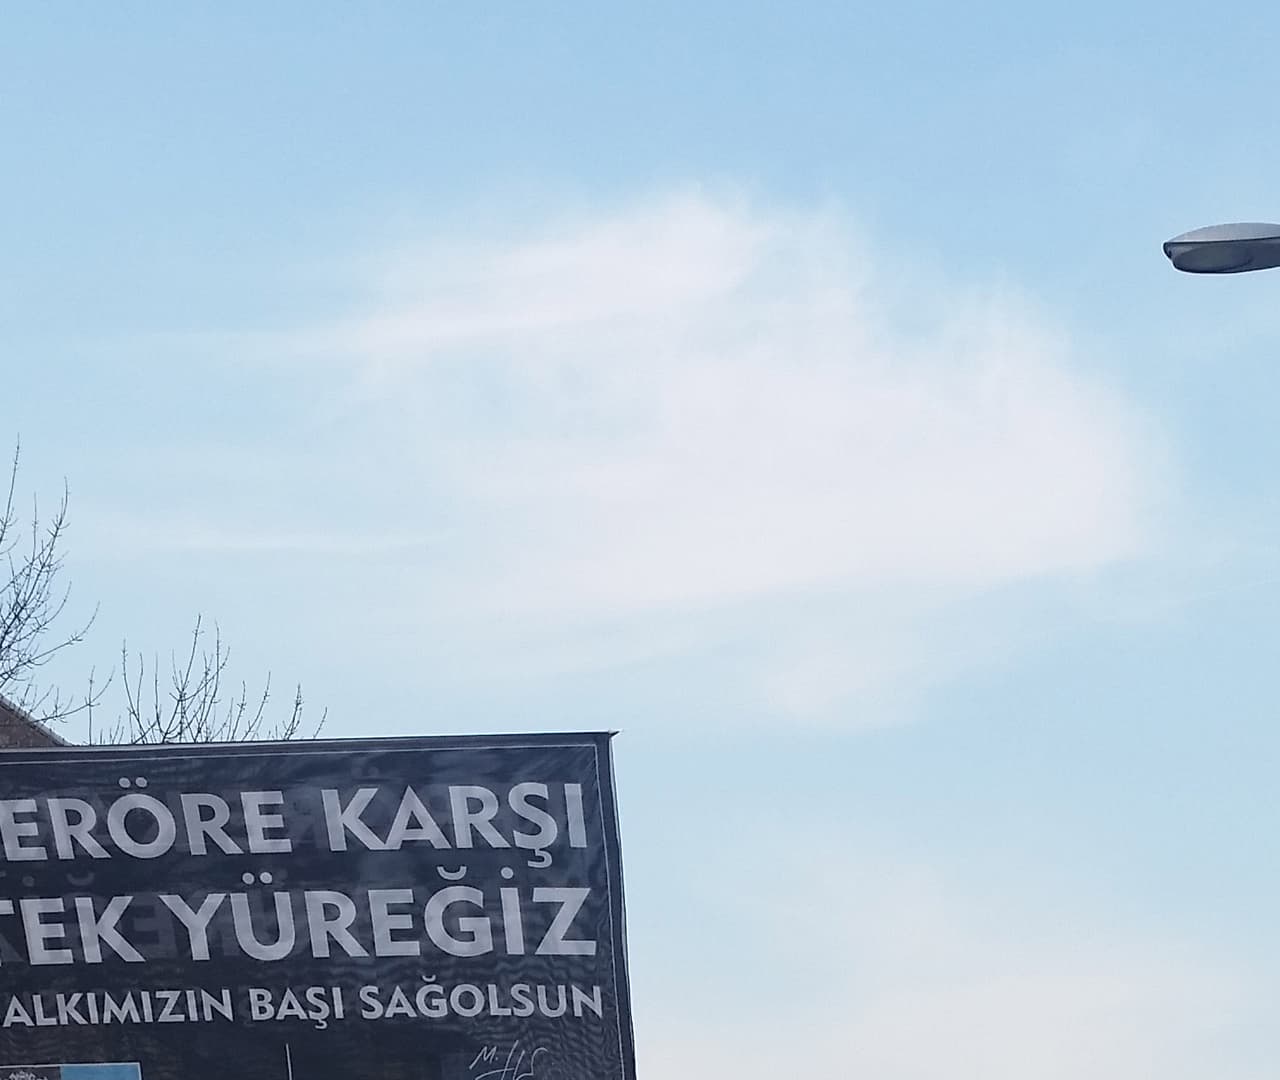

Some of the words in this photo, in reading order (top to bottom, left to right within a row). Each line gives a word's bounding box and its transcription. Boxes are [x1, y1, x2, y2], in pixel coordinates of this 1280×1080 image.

[320, 781, 587, 870] KARŞI
[159, 864, 597, 962] YÜREĞİZ
[250, 987, 345, 1029] BAŞI
[359, 975, 602, 1020] SAĞOLSUN
